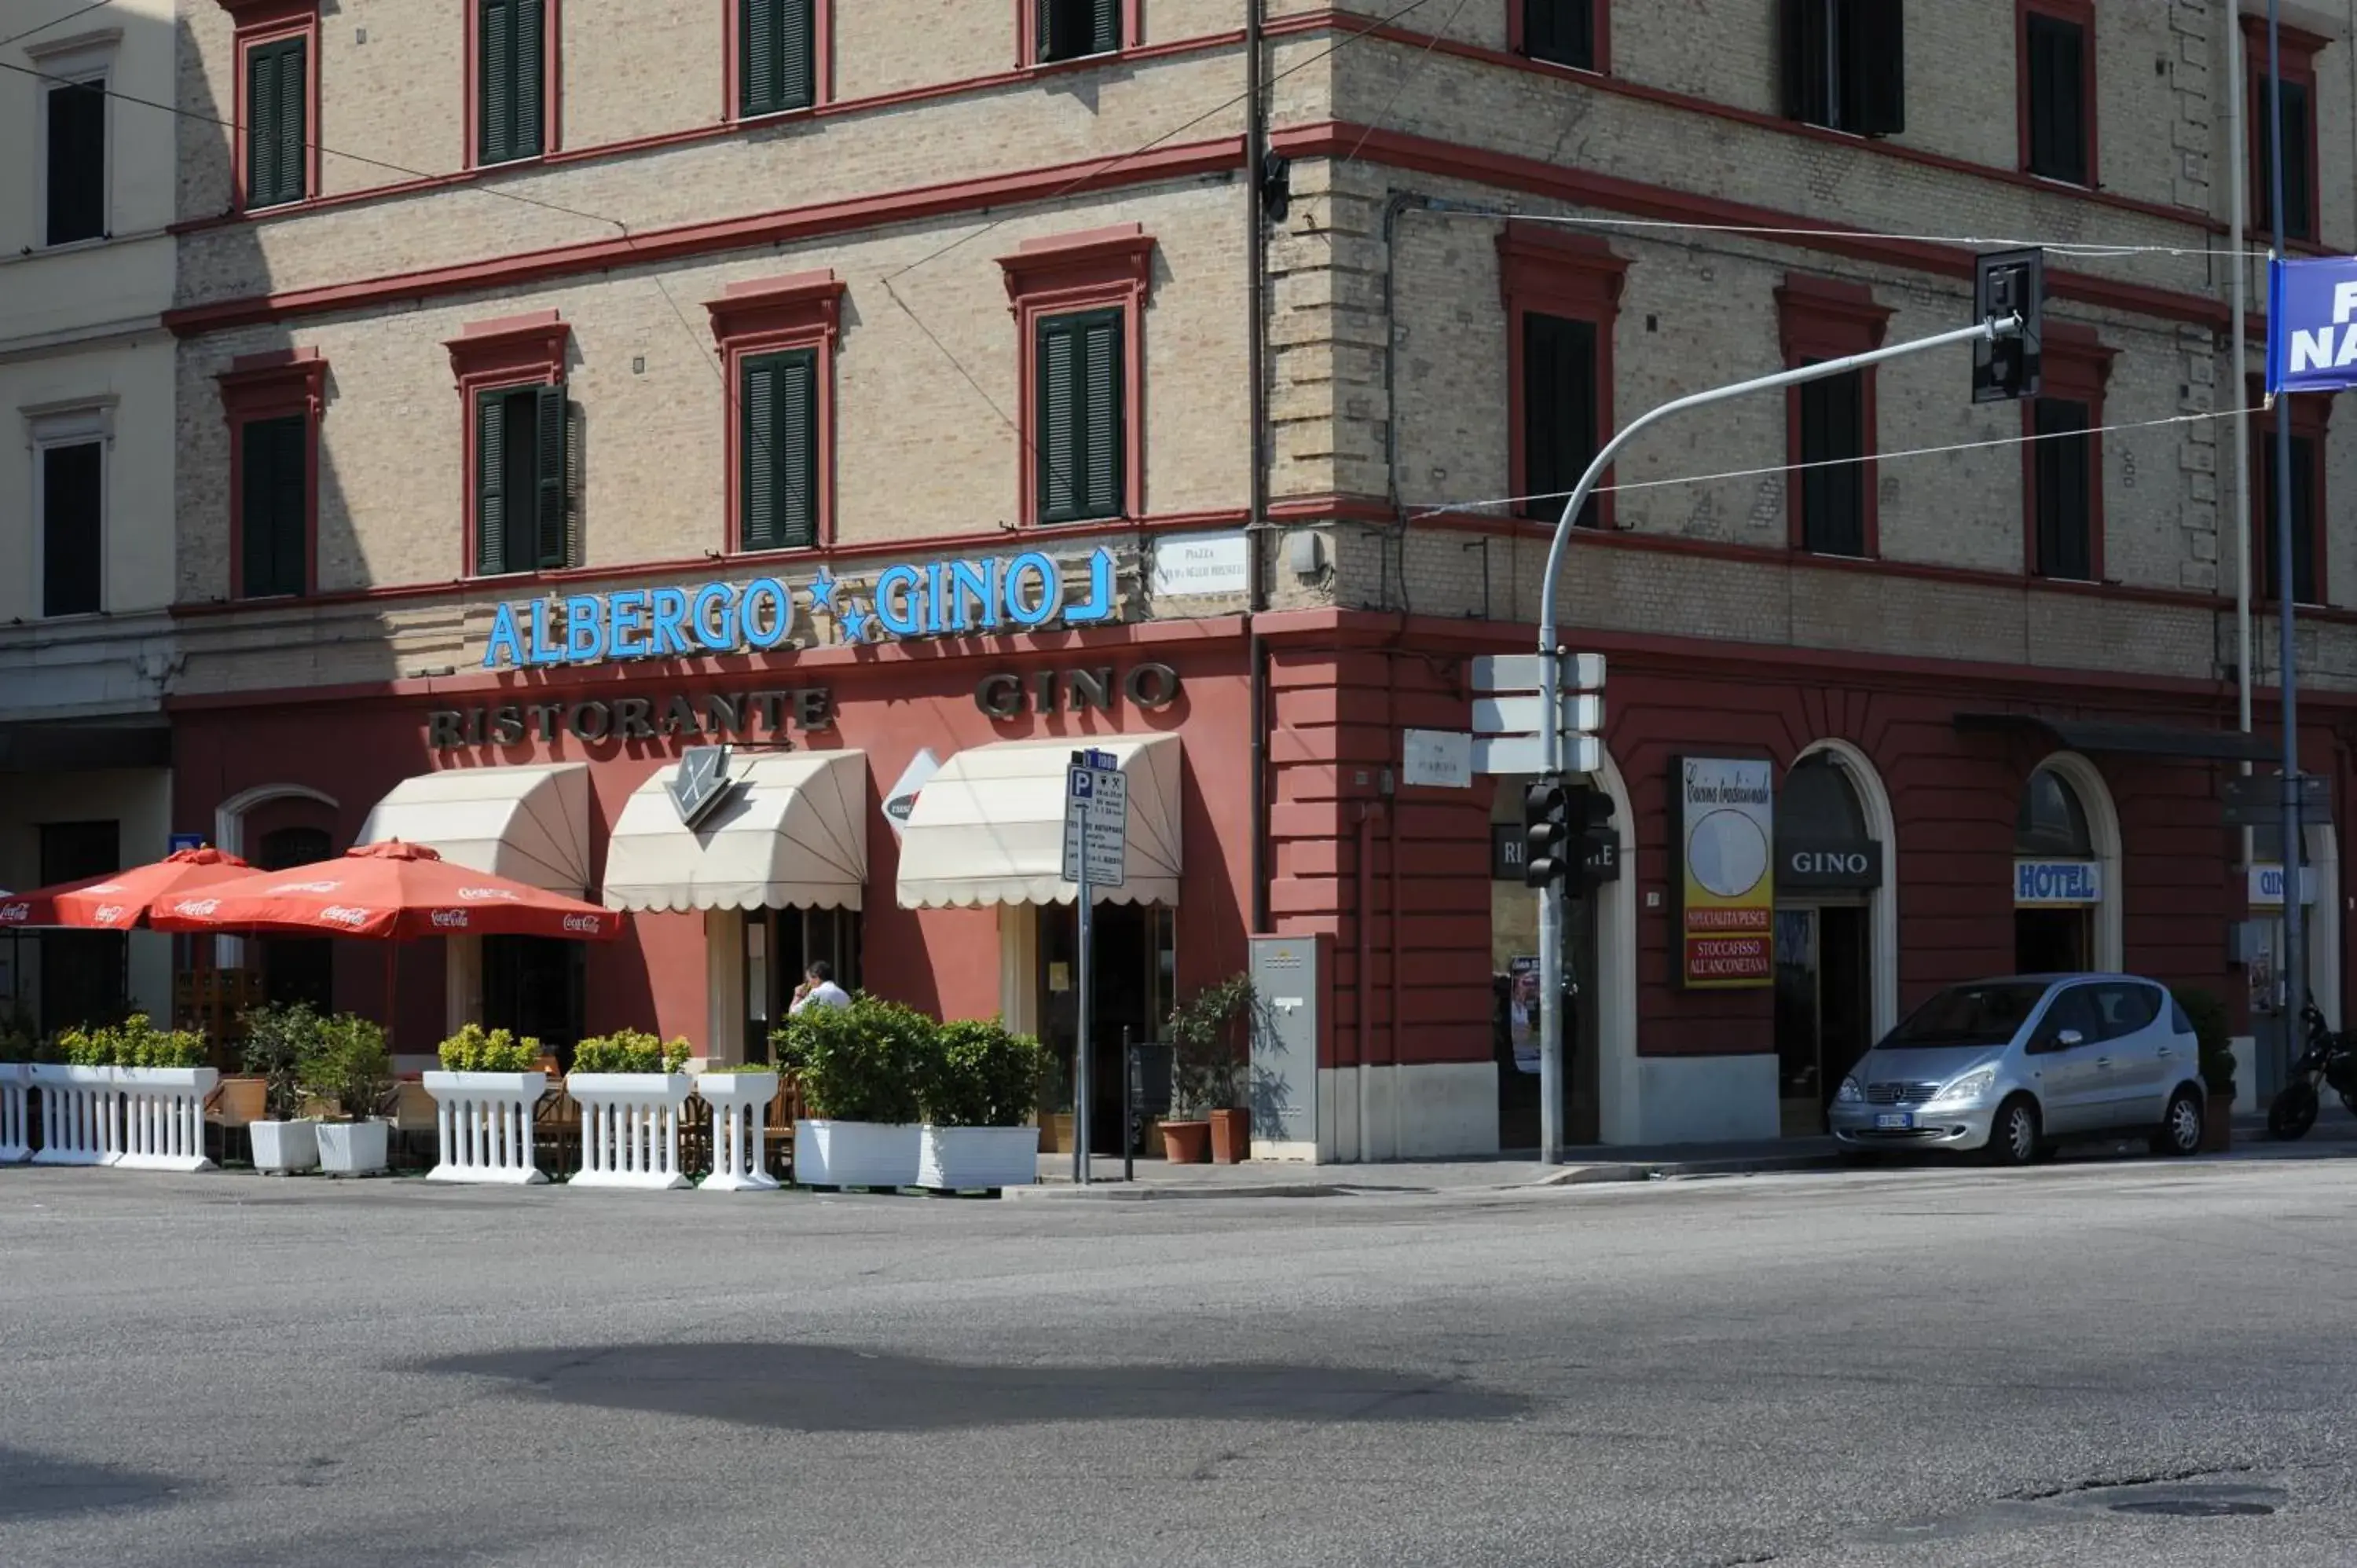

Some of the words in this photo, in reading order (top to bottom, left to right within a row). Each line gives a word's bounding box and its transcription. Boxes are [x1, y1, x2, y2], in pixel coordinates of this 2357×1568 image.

[482, 577, 792, 668] ALBERGO
[875, 551, 1058, 637] GINO
[428, 687, 835, 749] RISTORANTE
[974, 661, 1178, 721] GINO
[1076, 772, 1091, 796] P
[1791, 852, 1868, 874] GINO
[2018, 864, 2095, 898] HOTEL
[1697, 941, 1760, 956] STOCCAFISSO
